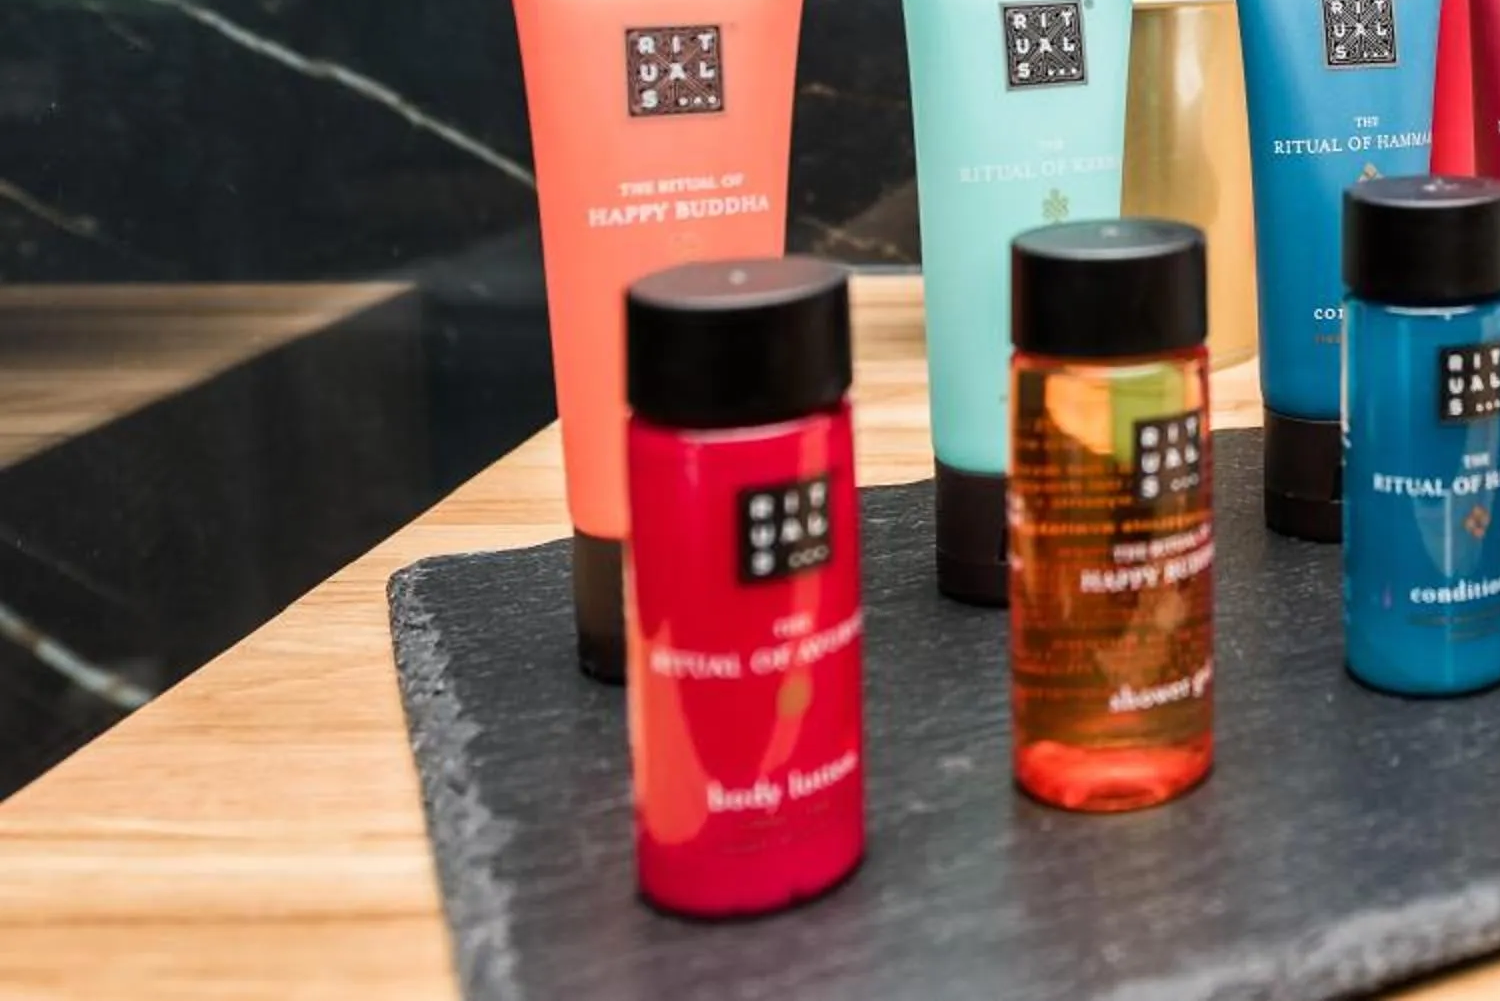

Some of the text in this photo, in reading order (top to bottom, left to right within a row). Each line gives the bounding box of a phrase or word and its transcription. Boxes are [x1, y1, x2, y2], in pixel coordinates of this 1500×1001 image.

[1273, 138, 1343, 155] RITUAL
[1348, 135, 1373, 150] OF
[657, 175, 717, 194] RITUAL
[720, 172, 744, 187] OF
[588, 193, 770, 228] HAPPY BUDDHA
[1373, 472, 1449, 498] RITUAL
[1452, 474, 1482, 496] OF
[1080, 564, 1160, 594] HAPPY
[706, 779, 782, 816] body
